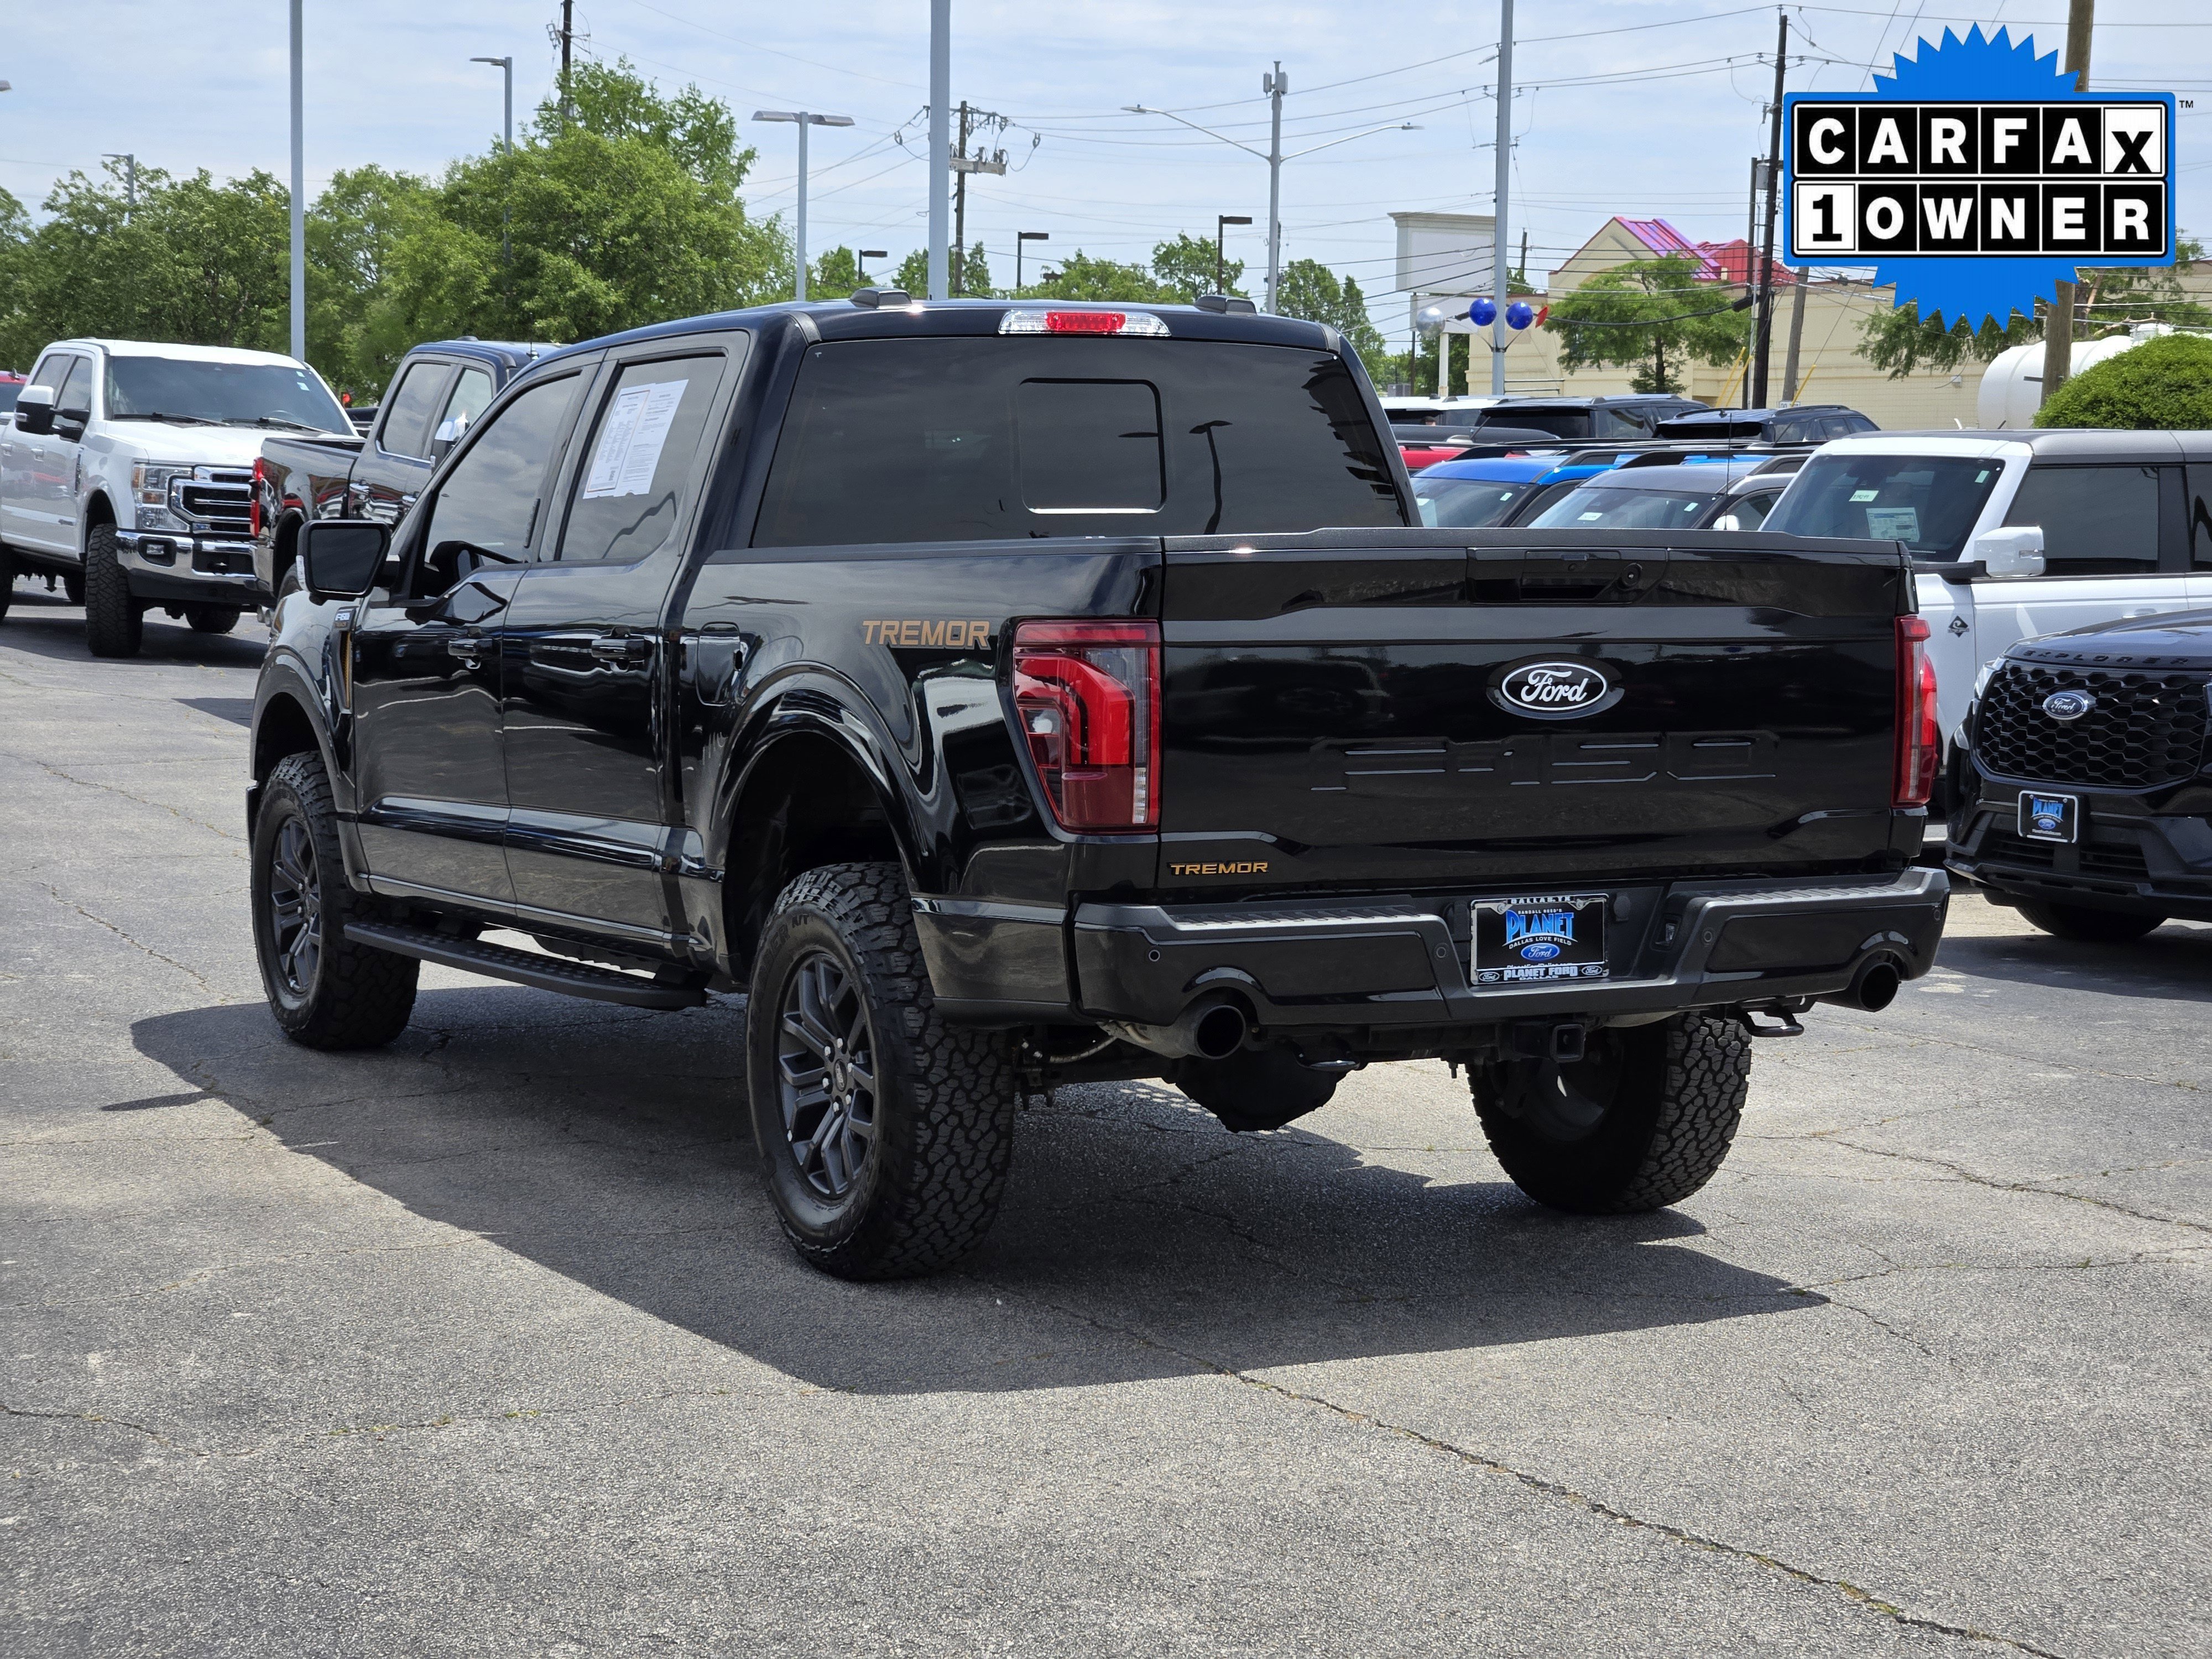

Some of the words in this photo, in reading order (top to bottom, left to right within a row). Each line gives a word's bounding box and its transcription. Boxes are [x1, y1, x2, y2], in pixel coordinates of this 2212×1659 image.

[863, 620, 990, 647] TREMOR
[2023, 650, 2189, 664] EXPLORER
[1521, 669, 1589, 702] Ford
[2051, 697, 2075, 712] Ford
[1170, 861, 1268, 875] TREMOR
[1505, 910, 1574, 943] PLANET
[1509, 937, 1533, 950] DALLAS
[1553, 937, 1572, 946] FIELD
[1528, 945, 1552, 958] Ford
[1504, 968, 1546, 981] PLANET
[1548, 966, 1578, 977] FORD
